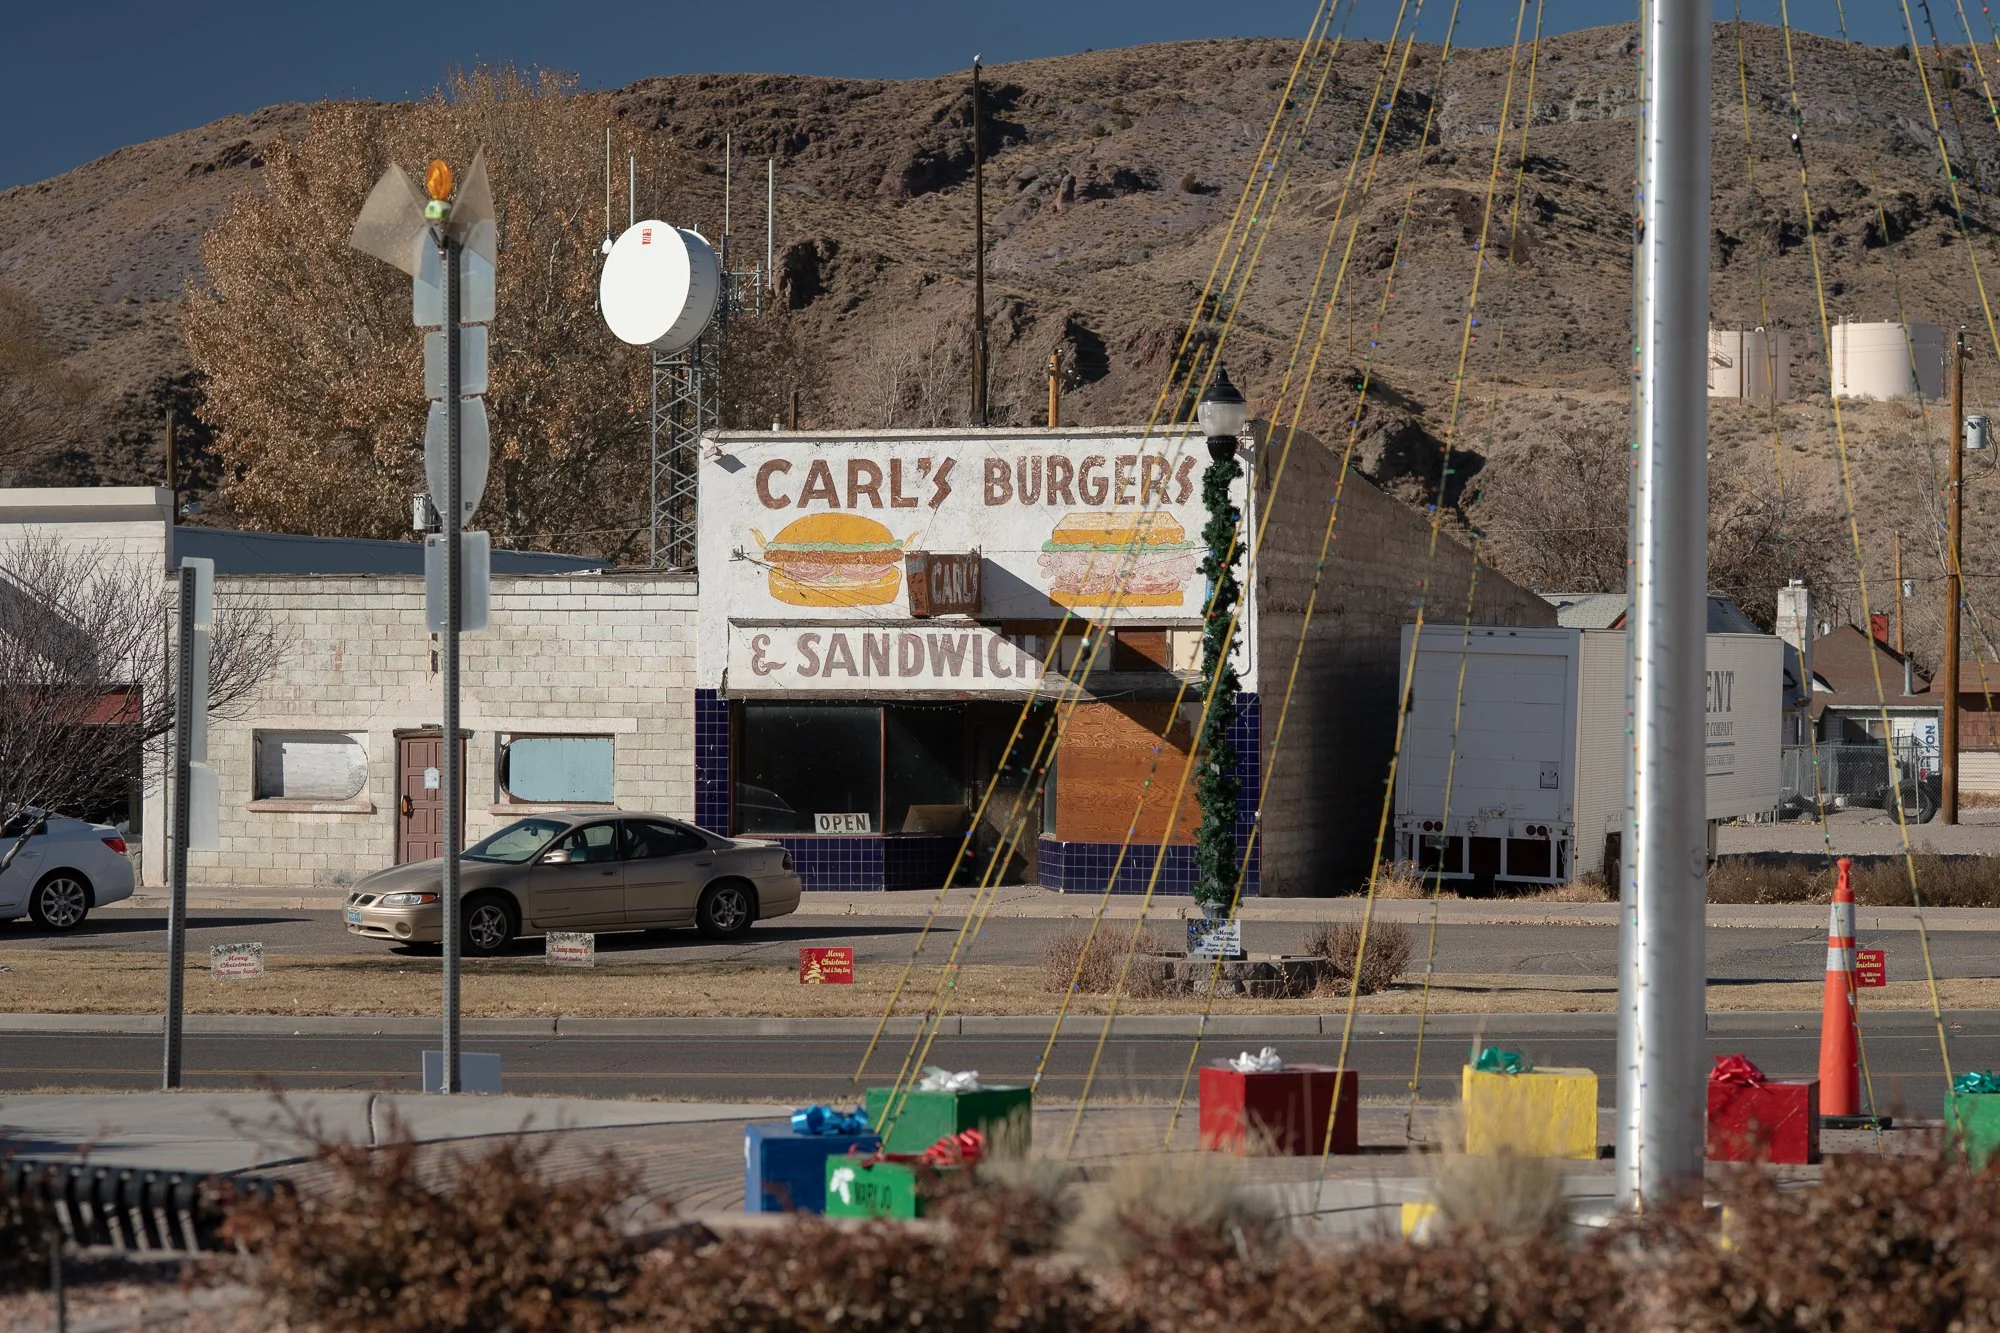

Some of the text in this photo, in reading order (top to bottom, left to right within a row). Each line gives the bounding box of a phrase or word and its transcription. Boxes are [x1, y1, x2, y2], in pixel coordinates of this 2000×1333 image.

[755, 455, 1197, 510] CARL'S BURGERS
[751, 632, 1045, 680] & SANDWICH
[820, 815, 867, 831] OPEN
[826, 950, 845, 958] Merry
[1856, 952, 1876, 961] Merry
[821, 958, 850, 966] Christmas
